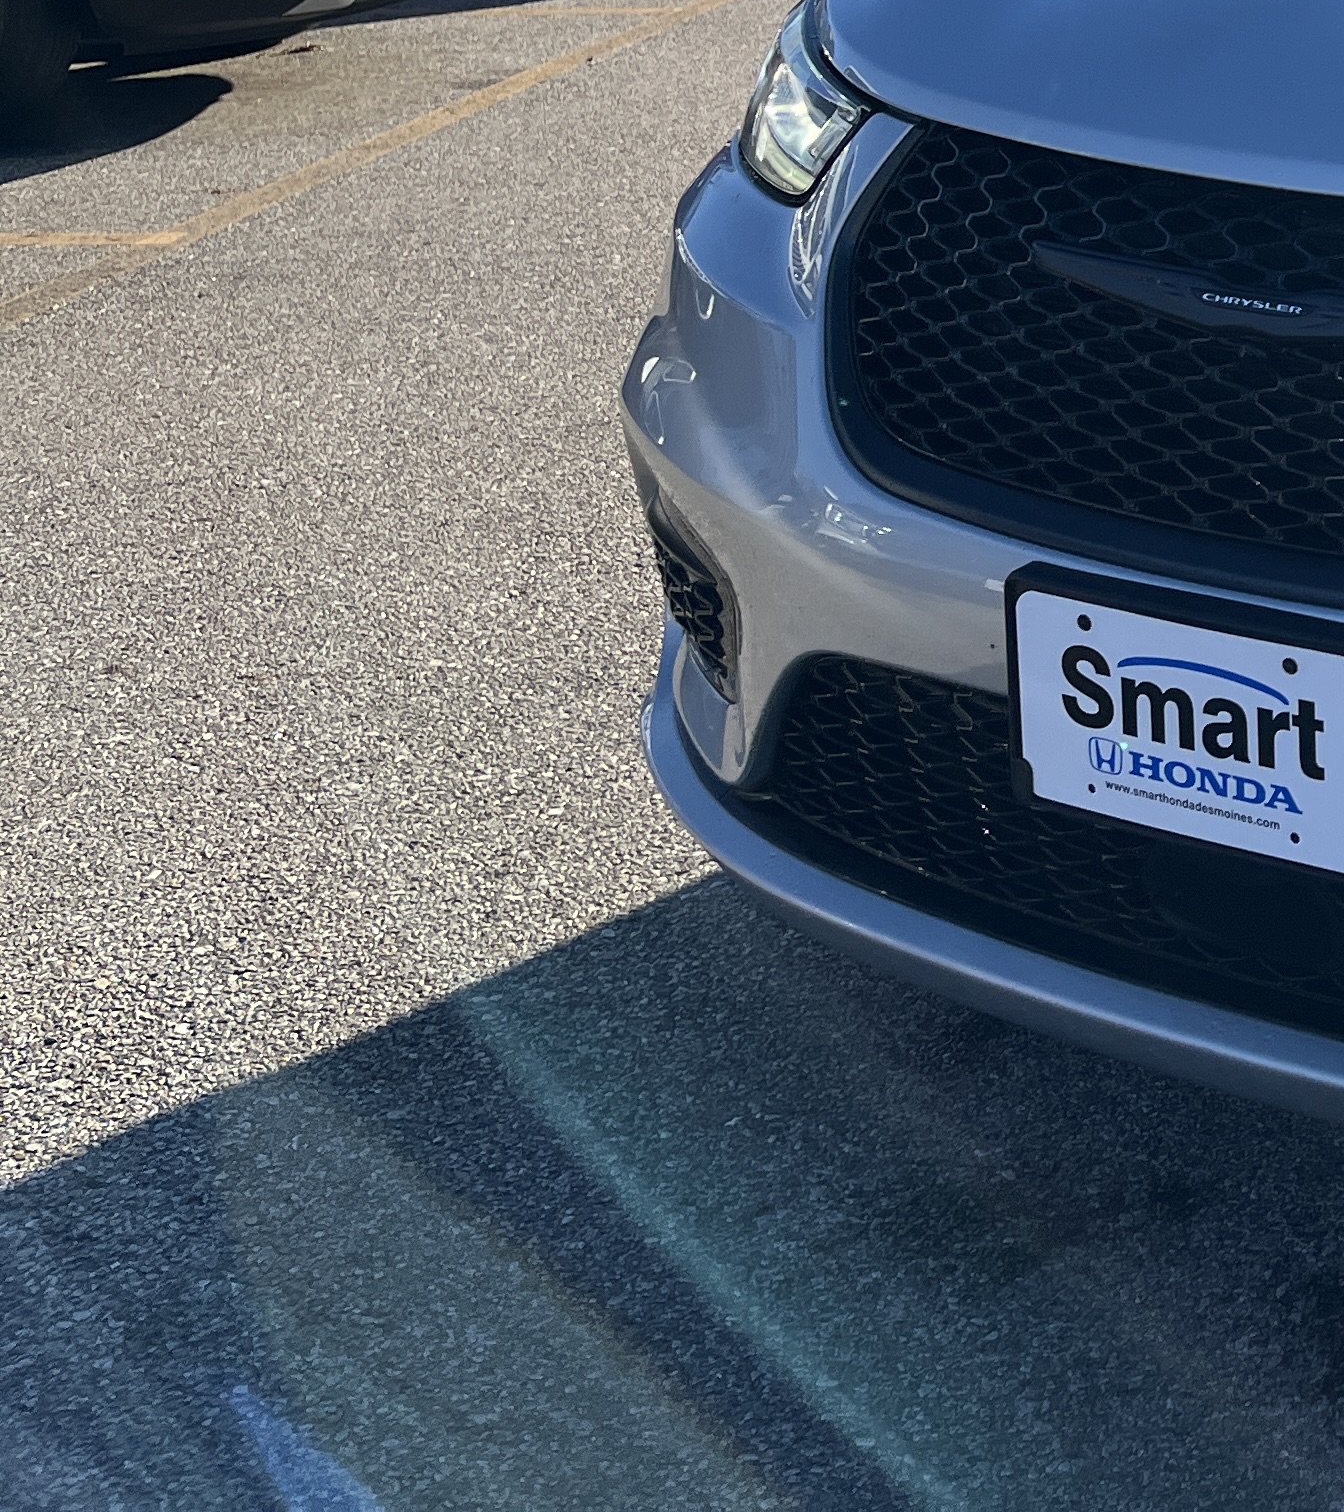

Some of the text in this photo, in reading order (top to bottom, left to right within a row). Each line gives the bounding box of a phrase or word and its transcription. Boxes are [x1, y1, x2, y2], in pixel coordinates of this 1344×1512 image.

[1202, 292, 1303, 315] CHRYSLER
[1061, 644, 1326, 781] Smart
[1105, 779, 1281, 831] www.smarthondadesmoines.com
[1129, 750, 1304, 815] HONDA
